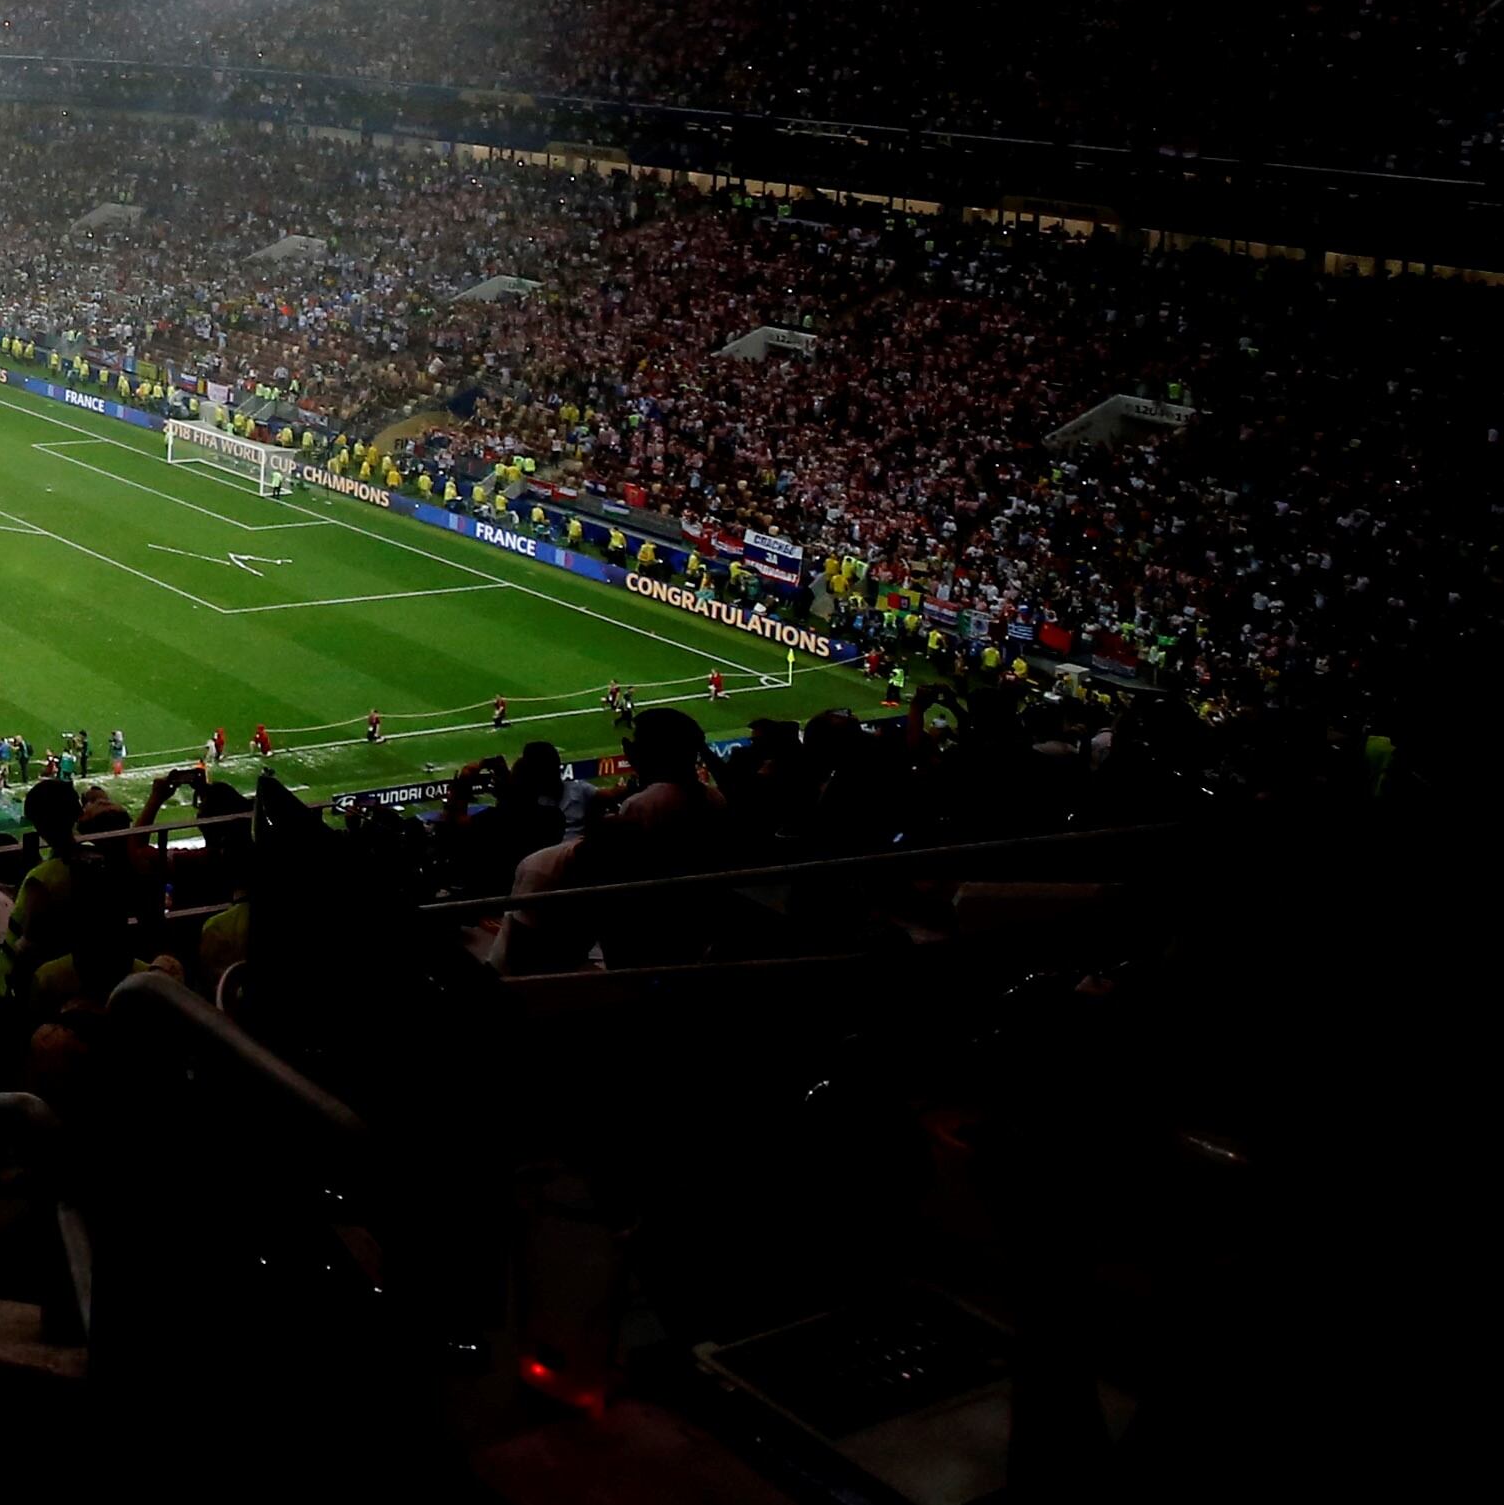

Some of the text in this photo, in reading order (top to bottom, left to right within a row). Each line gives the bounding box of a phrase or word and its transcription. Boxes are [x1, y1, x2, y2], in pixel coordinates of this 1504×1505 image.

[65, 389, 106, 413] FRANCE
[193, 430, 218, 450] FIFA
[302, 465, 390, 507] CHAMPIONS
[474, 521, 537, 557] FRANCE
[625, 572, 831, 658] CONGRATULATIONS
